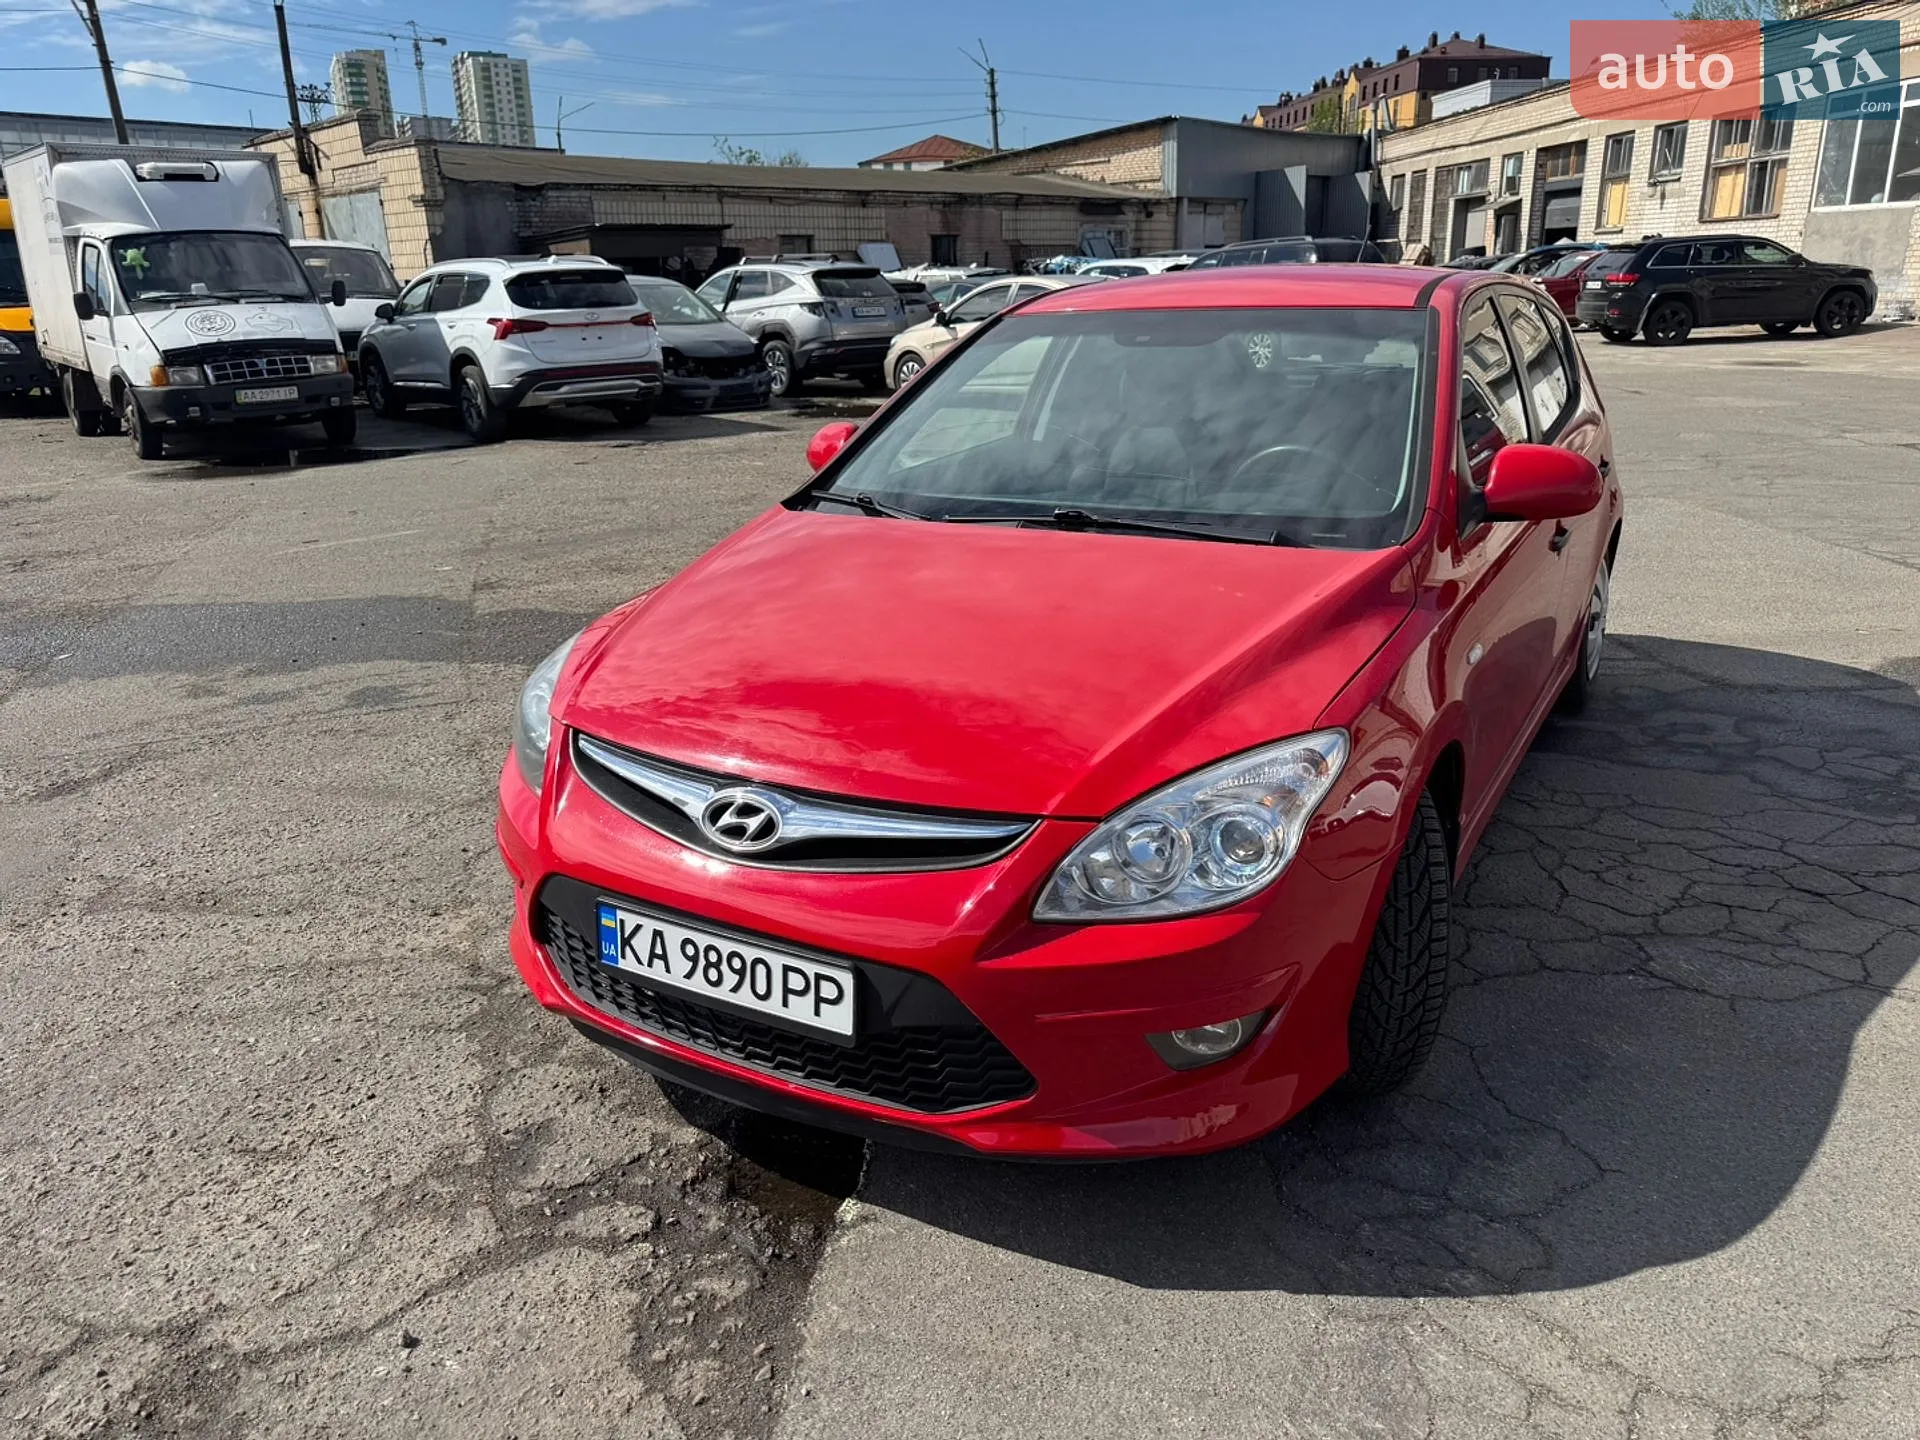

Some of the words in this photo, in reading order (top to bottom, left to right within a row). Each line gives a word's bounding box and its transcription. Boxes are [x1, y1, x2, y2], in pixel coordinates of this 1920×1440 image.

[602, 940, 617, 957] UA
[619, 917, 672, 975] KA
[680, 938, 773, 1001] 9890
[782, 963, 845, 1018] PP
